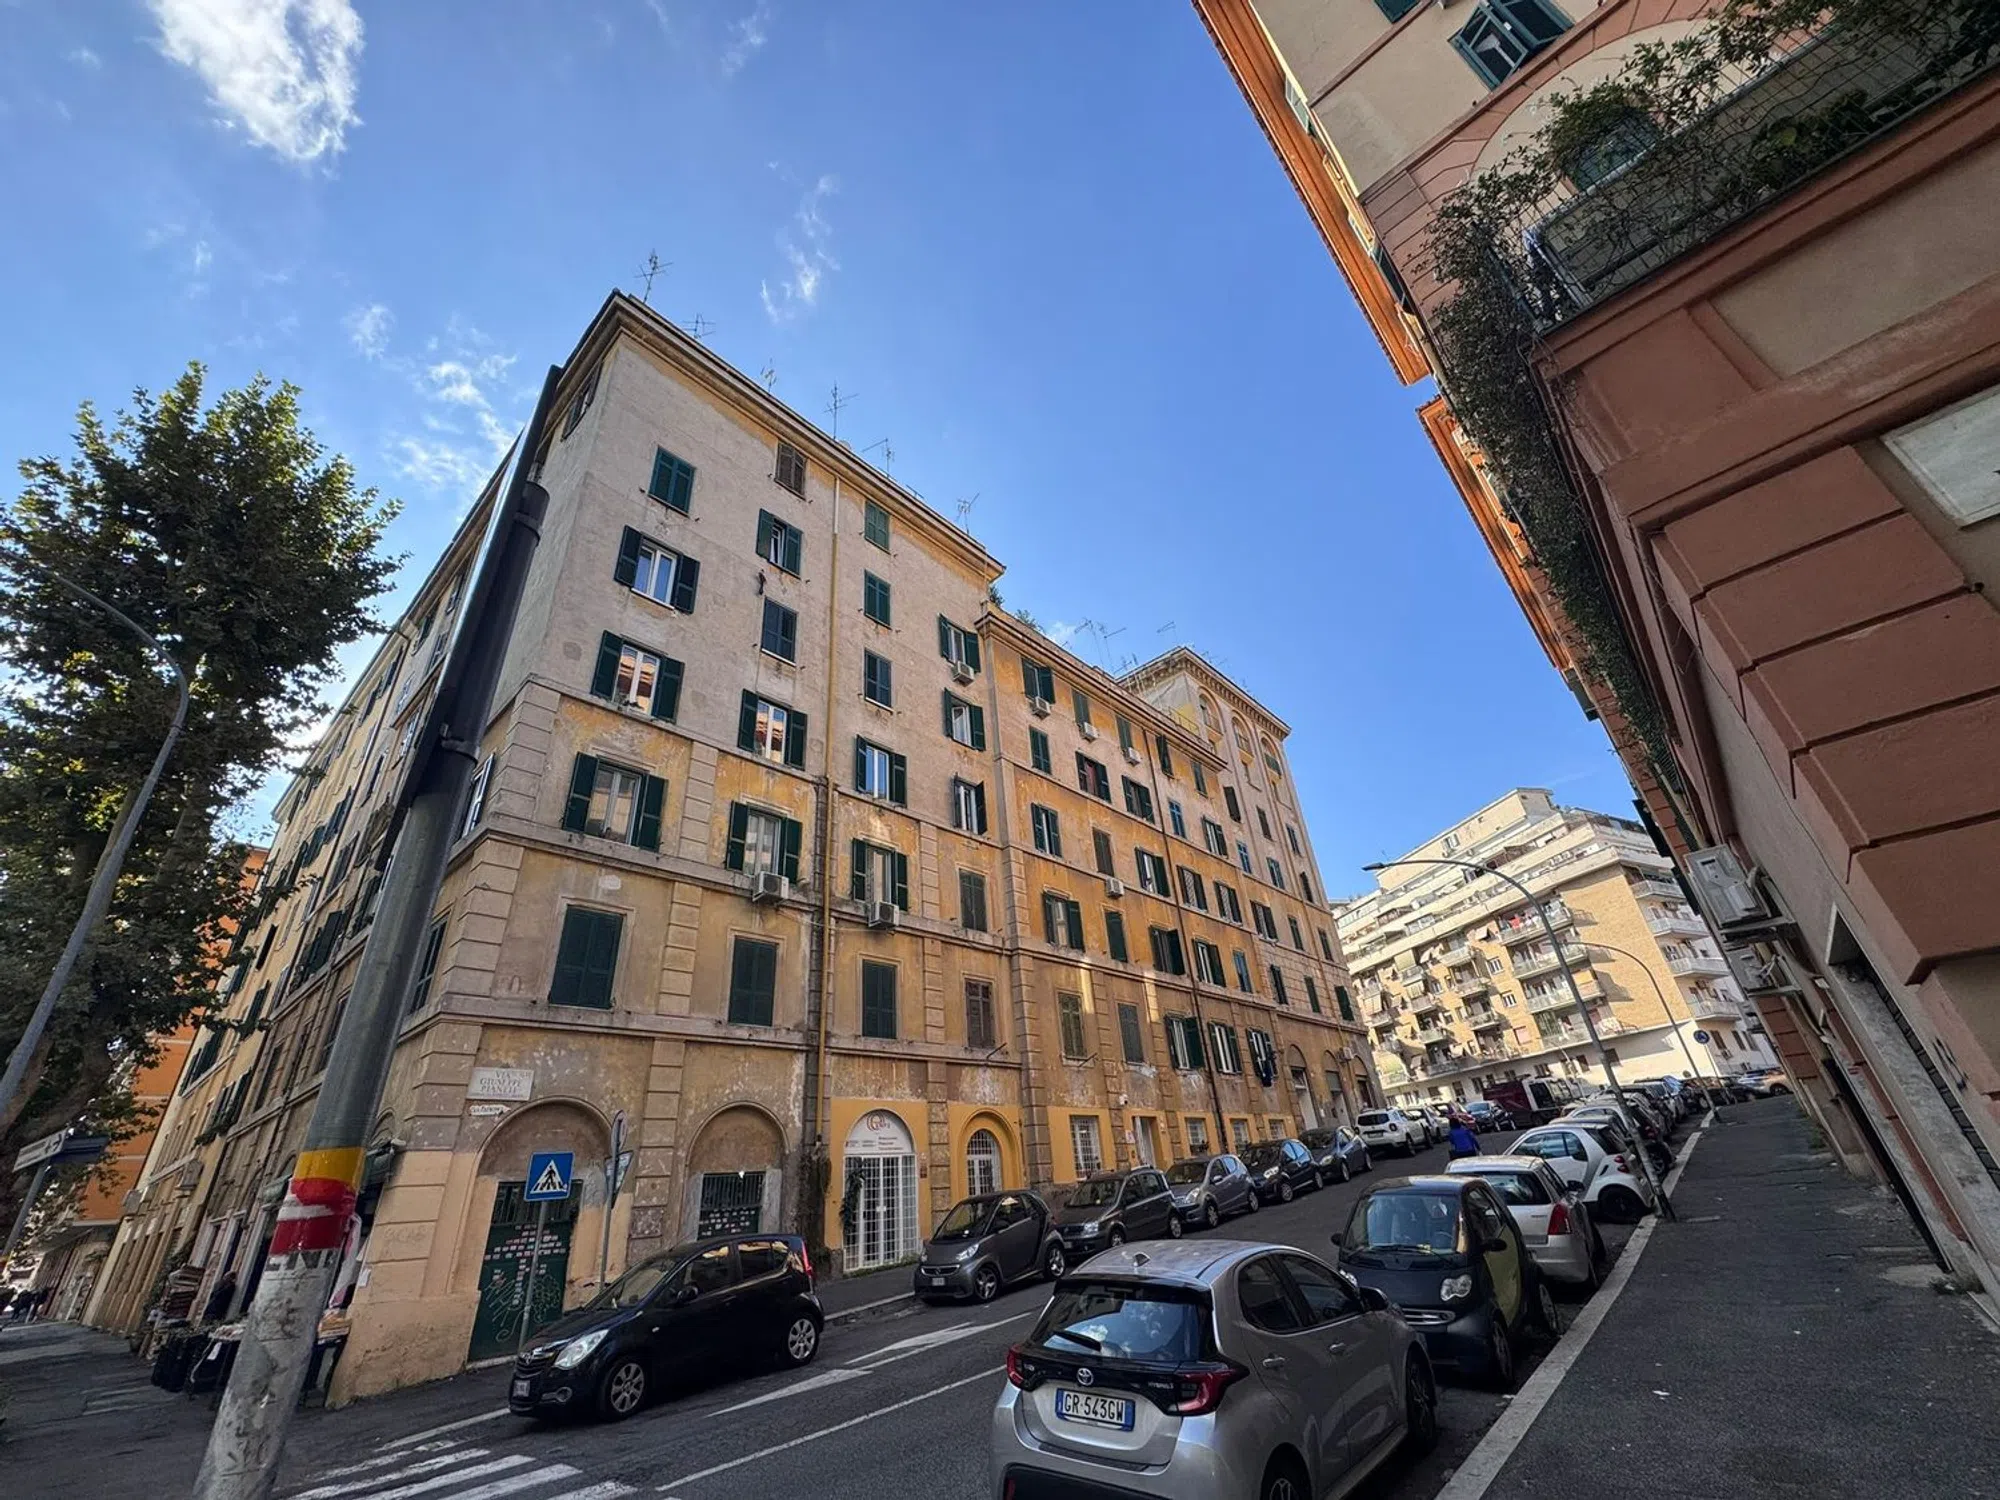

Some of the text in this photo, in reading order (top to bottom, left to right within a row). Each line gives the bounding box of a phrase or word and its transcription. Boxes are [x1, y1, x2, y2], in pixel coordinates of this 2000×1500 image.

[495, 1070, 511, 1079] VIA
[1064, 1393, 1124, 1422] GR 543GW
